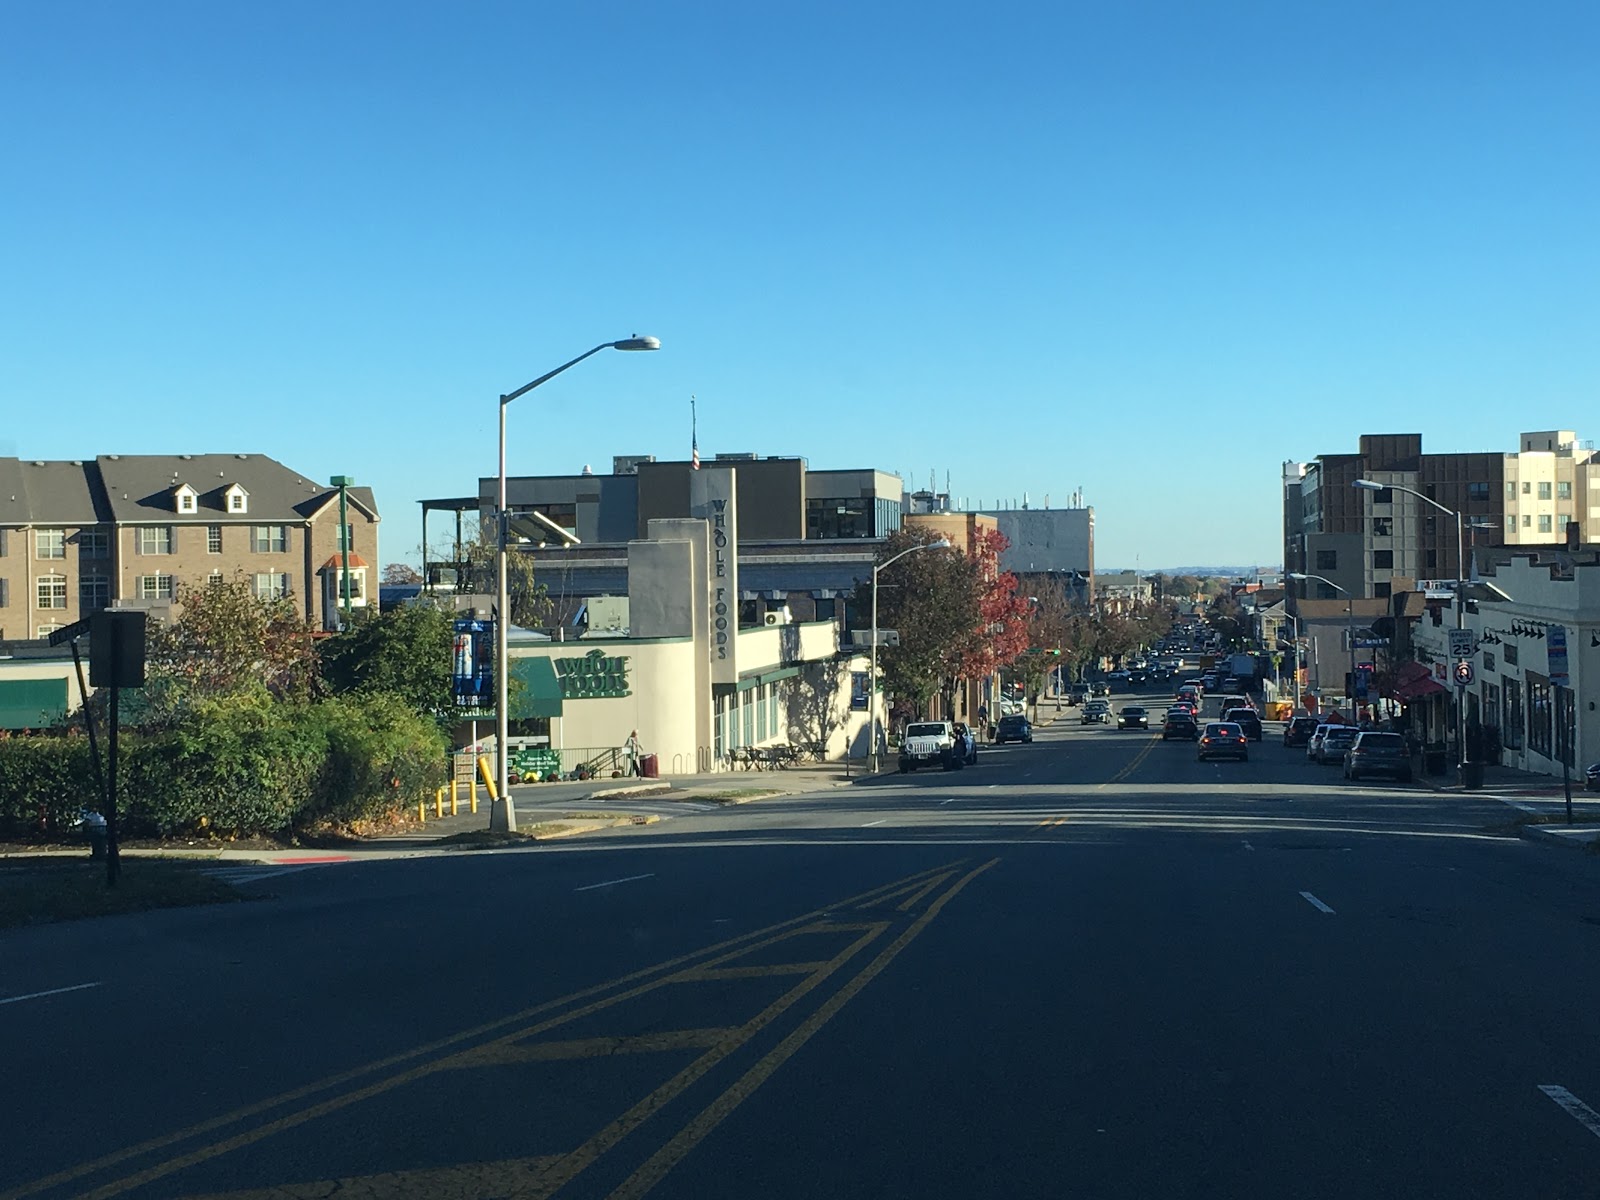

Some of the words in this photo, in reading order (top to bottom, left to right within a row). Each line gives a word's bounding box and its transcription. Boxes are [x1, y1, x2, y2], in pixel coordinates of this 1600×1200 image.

[712, 499, 727, 577] WHOLE
[715, 588, 727, 660] FOODS
[1453, 644, 1471, 655] 25
[556, 655, 632, 674] WHOLE
[560, 674, 629, 692] FOODS
